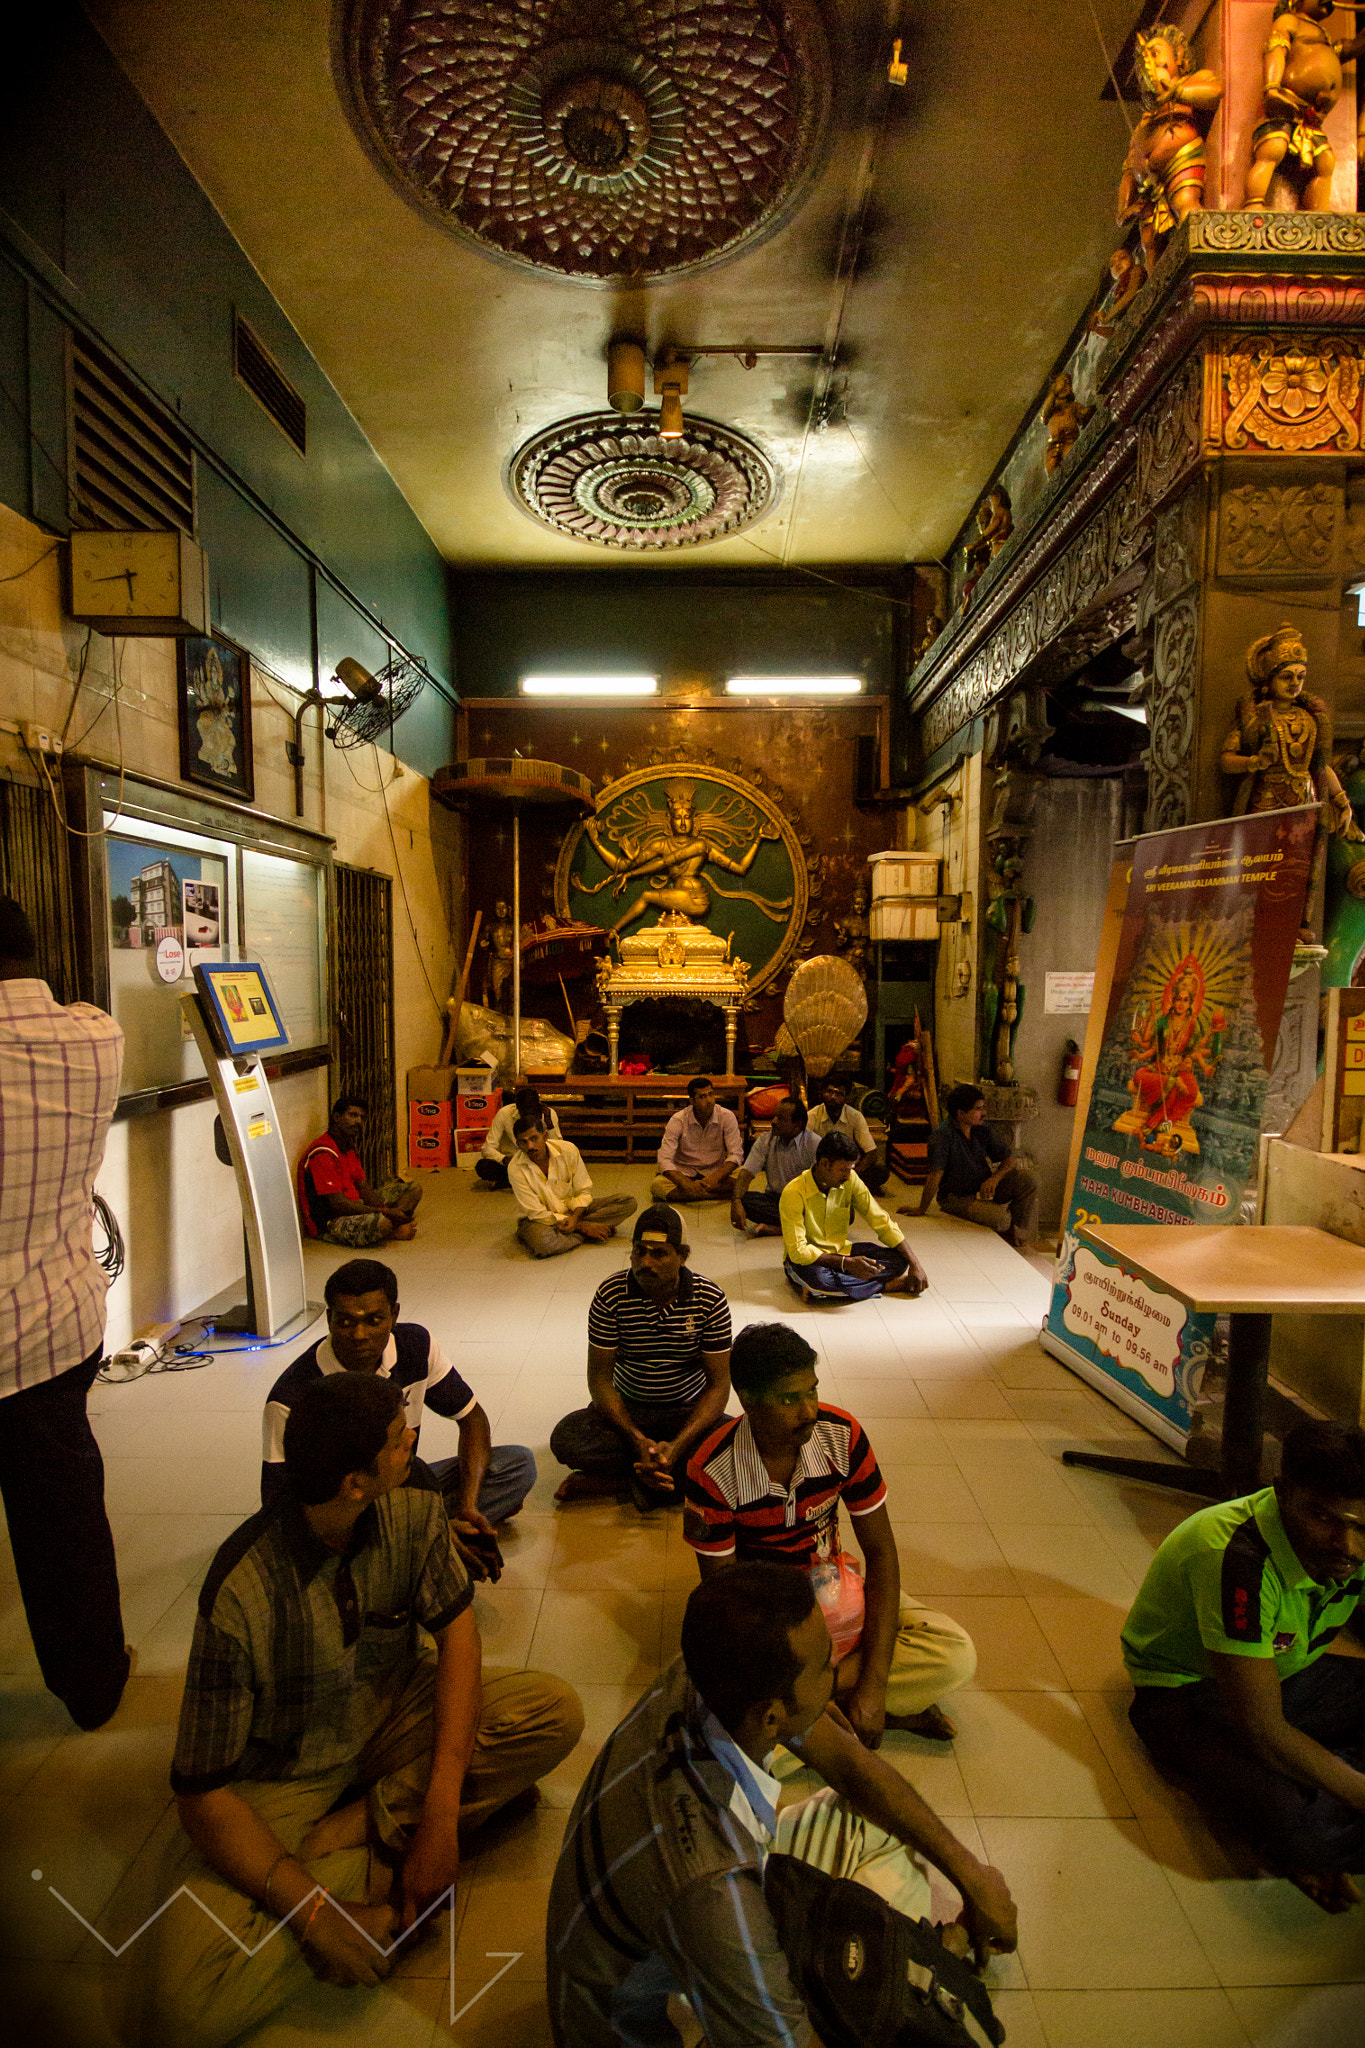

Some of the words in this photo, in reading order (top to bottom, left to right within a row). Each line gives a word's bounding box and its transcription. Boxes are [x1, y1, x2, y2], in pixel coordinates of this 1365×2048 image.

[1145, 883, 1156, 893] SRI
[1241, 871, 1278, 884] TEMPLE
[165, 949, 180, 959] Lose
[1080, 1176, 1109, 1198] MAHA
[1100, 1300, 1141, 1338] Sunday
[1072, 1304, 1093, 1326] 09.01
[1094, 1321, 1108, 1335] am
[1112, 1330, 1121, 1344] to
[1125, 1339, 1152, 1364] 09.56
[1153, 1359, 1168, 1376] am
